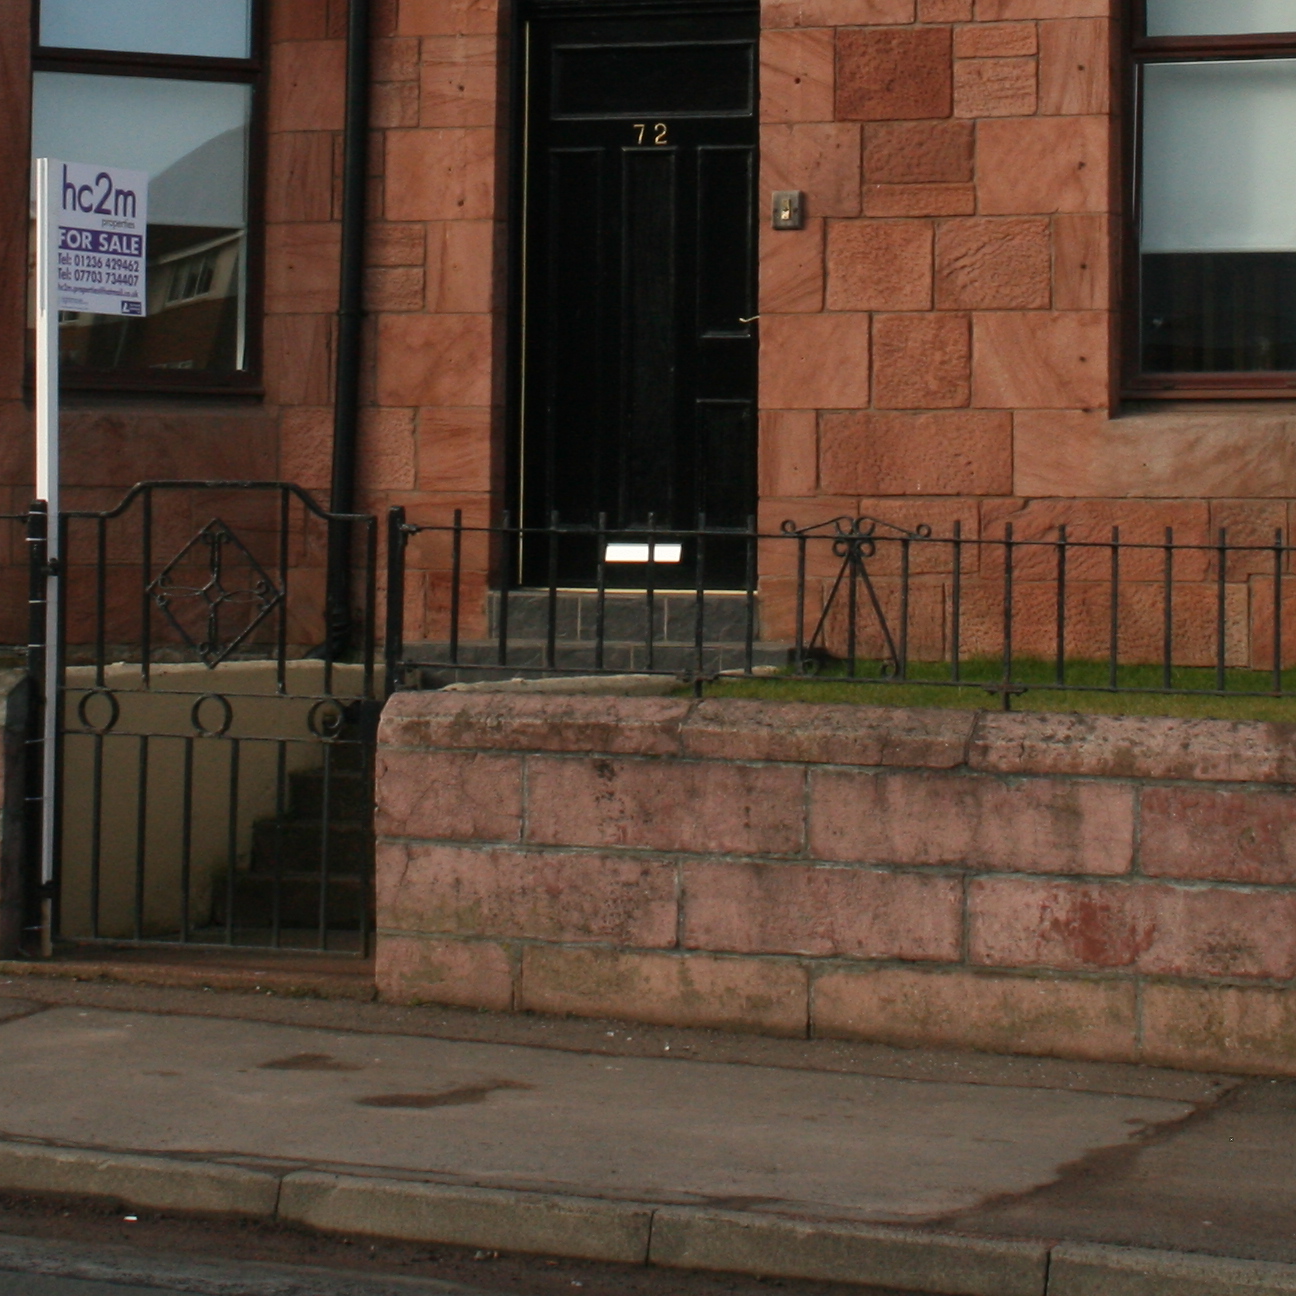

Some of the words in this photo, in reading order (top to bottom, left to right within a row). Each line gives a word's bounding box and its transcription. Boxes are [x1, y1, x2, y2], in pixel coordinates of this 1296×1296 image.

[633, 123, 667, 144] 72
[62, 163, 137, 218] hc2m
[101, 218, 135, 230] properties
[58, 229, 92, 250] FOR
[99, 233, 140, 255] SALE
[58, 252, 72, 266] Tel:
[74, 254, 102, 269] 01236
[105, 258, 139, 272] 429462
[58, 267, 72, 280] Tel:
[74, 269, 102, 283] 07703
[105, 272, 139, 286] 734407
